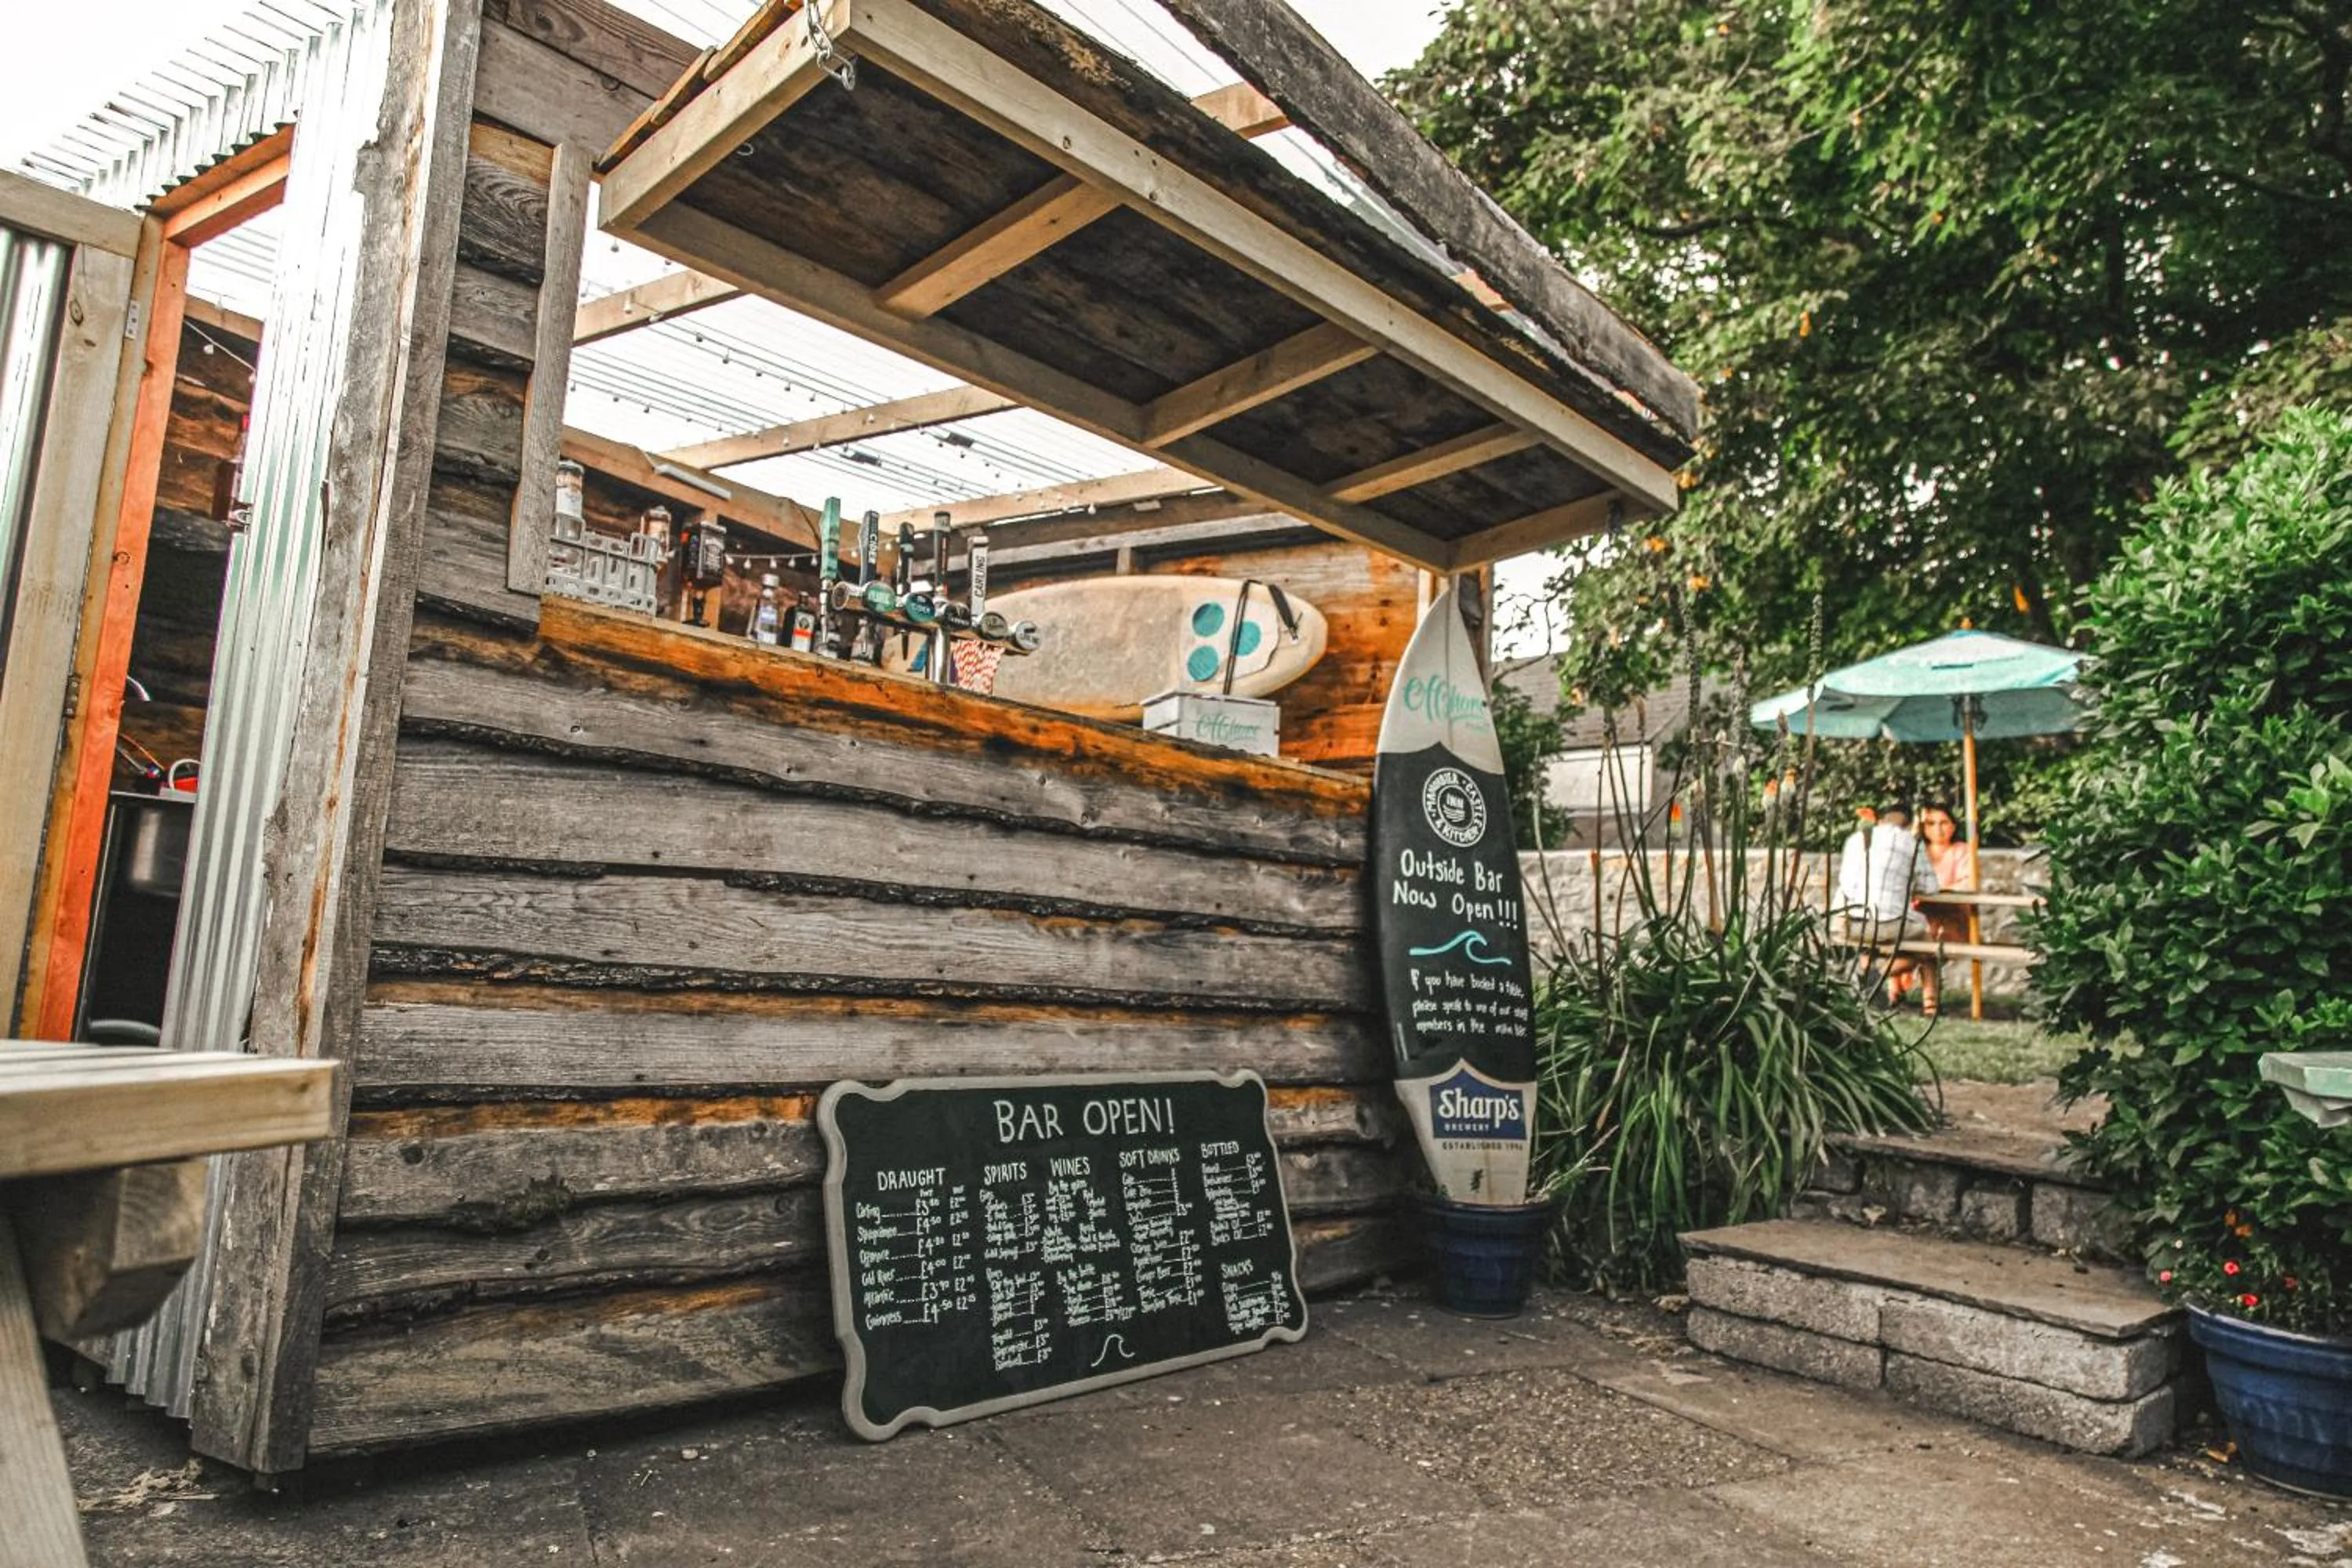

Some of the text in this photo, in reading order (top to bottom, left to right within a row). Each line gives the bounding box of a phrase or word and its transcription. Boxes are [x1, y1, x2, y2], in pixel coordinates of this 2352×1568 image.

[975, 554, 985, 598] CARLING
[1465, 783, 1483, 828] CASTLE
[1443, 825, 1480, 843] KITCHEN
[1400, 848, 1504, 893] Outside Bar
[1392, 879, 1437, 909] Now
[1425, 976, 1442, 996] you
[1445, 970, 1465, 988] have
[1470, 973, 1495, 991] booked
[1412, 999, 1438, 1018] please
[1442, 998, 1462, 1014] speak
[1464, 999, 1472, 1012] to
[1490, 1000, 1497, 1017] of
[1416, 1018, 1453, 1034] members
[1457, 1020, 1465, 1033] in
[1470, 1018, 1486, 1033] the
[1438, 1087, 1520, 1129] Sharp's
[994, 1098, 1176, 1143] BAR OPEN!
[1444, 1123, 1490, 1131] BREWERY
[1200, 1141, 1240, 1159] BOTTLED
[1443, 1142, 1502, 1151] ESTABLISHED
[1050, 1156, 1091, 1177] WINES
[1119, 1149, 1145, 1169] SOFT
[1147, 1148, 1180, 1165] DRINKS
[877, 1167, 946, 1191] DRAUGHT
[984, 1162, 1028, 1185] SPIRITS
[855, 1202, 881, 1225] Carling
[1221, 1258, 1254, 1278] SNACKS
[866, 1311, 902, 1330] Guinness
